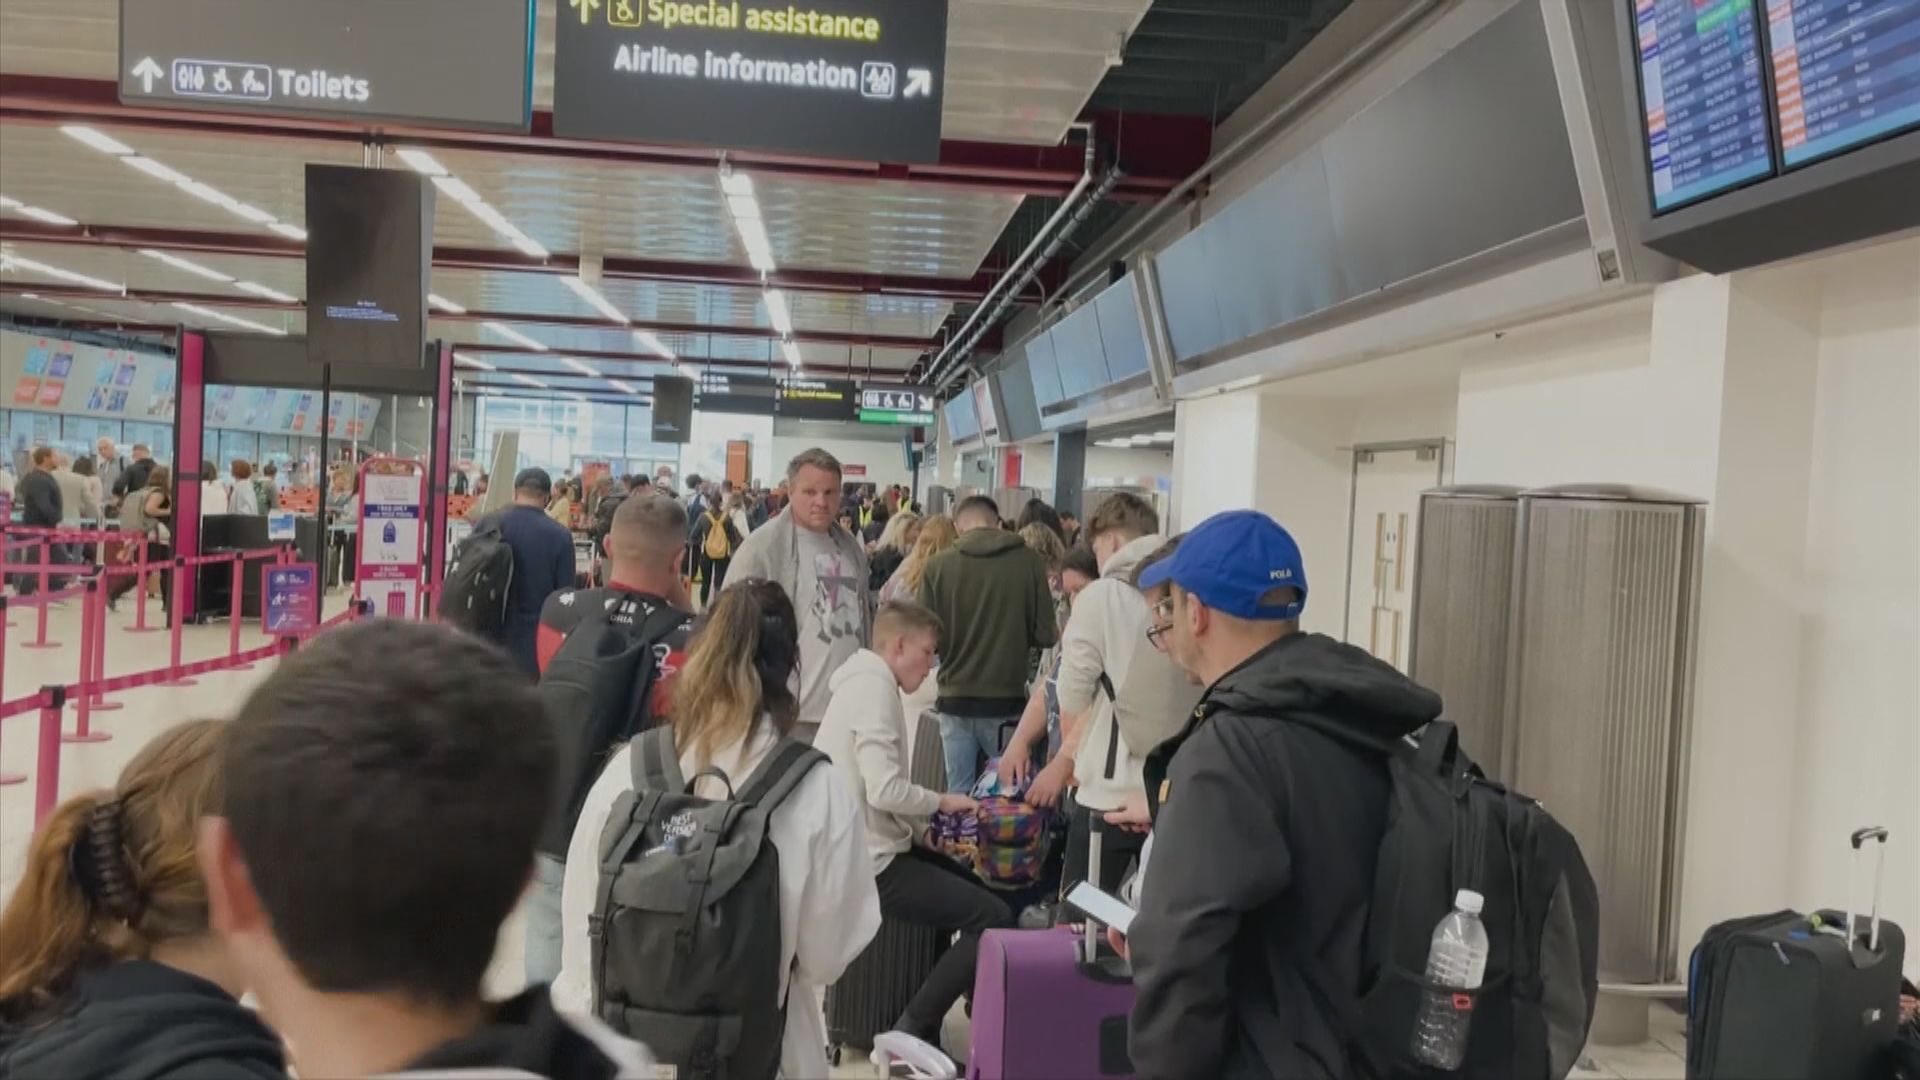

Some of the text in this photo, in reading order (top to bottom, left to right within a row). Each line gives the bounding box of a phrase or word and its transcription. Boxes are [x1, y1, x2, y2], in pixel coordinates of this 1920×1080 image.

[647, 0, 880, 41] Special assistance
[278, 68, 371, 102] Toilets
[614, 45, 857, 89] Airline information
[1270, 568, 1292, 580] POLO
